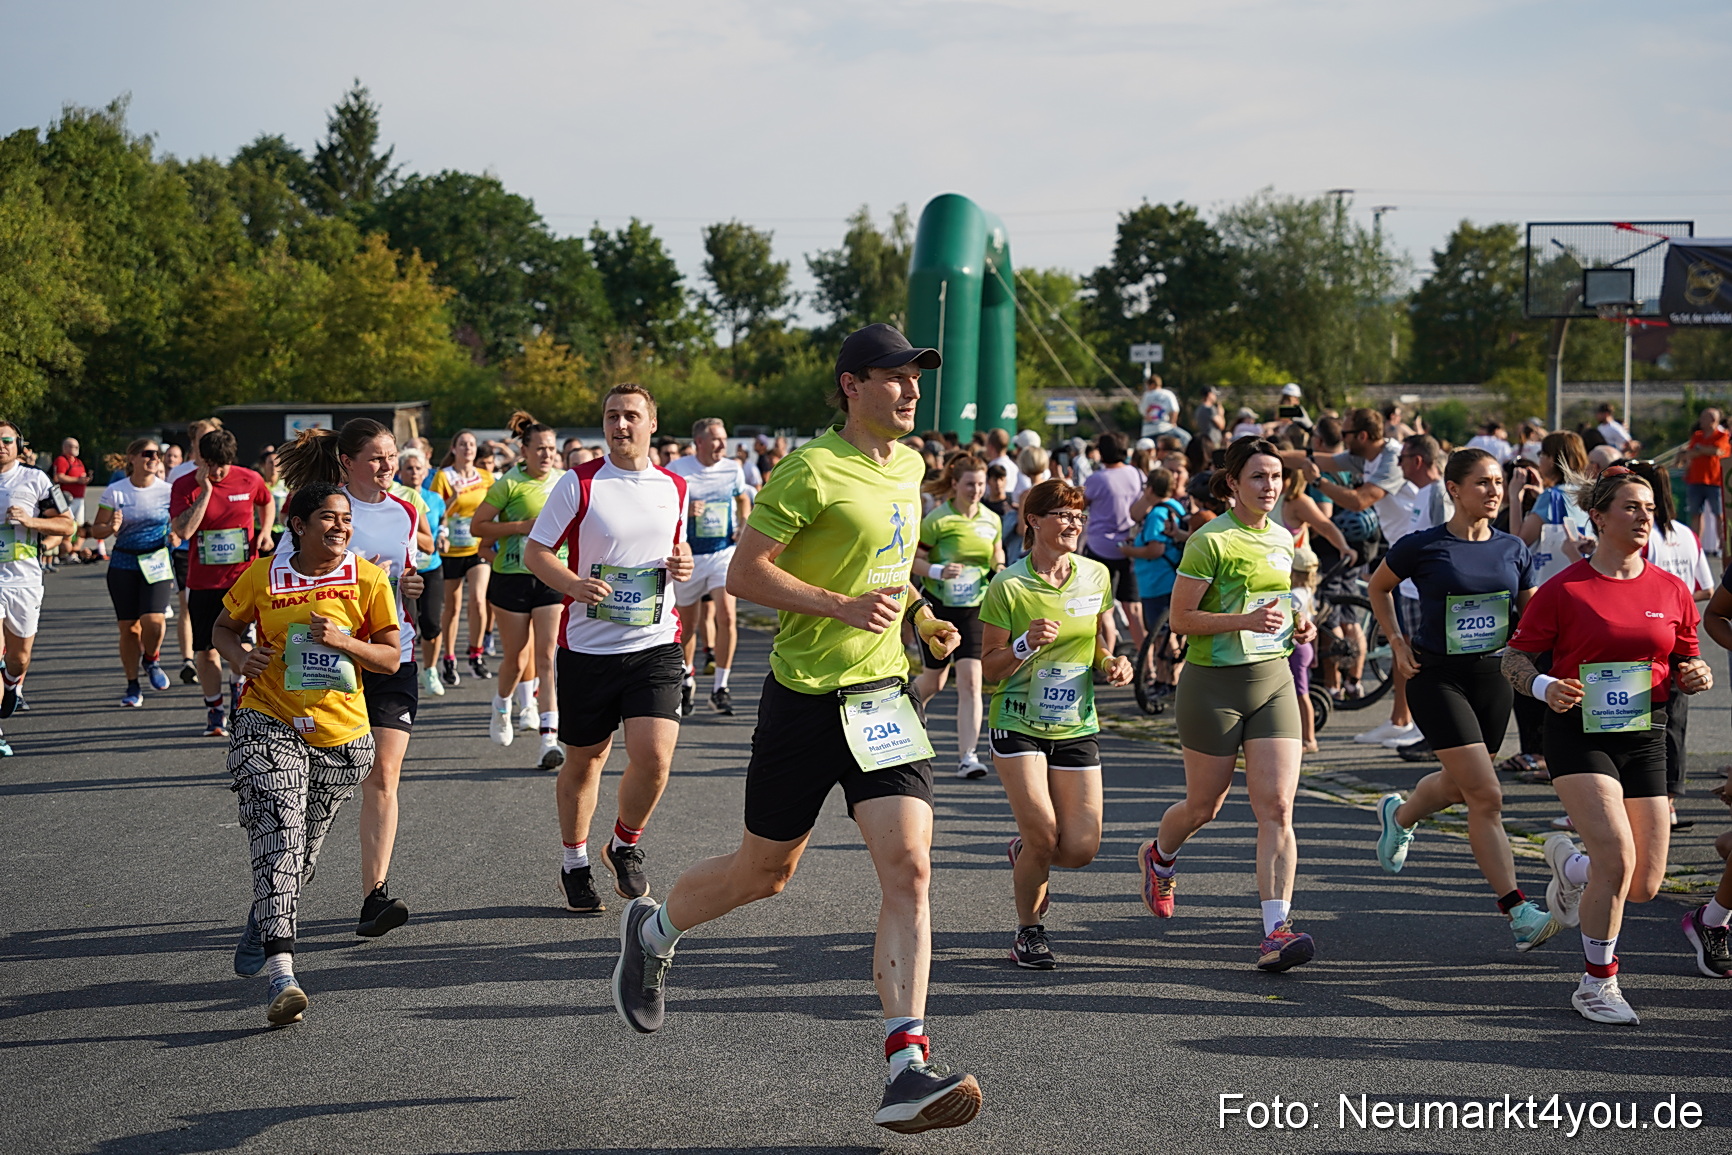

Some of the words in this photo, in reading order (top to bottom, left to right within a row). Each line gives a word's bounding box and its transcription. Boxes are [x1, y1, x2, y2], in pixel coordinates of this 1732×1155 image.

[211, 543, 236, 552] 2800
[271, 594, 310, 610] MAX
[315, 588, 358, 601] BÖGL
[613, 591, 642, 604] 526
[599, 603, 626, 611] Christoph
[1456, 615, 1496, 631] 2203
[301, 652, 340, 668] 1587
[1043, 687, 1076, 702] 1378
[1606, 691, 1629, 706] 68
[1040, 702, 1064, 710] Krystyna
[1615, 708, 1644, 716] Schweiger
[863, 721, 901, 742] 234
[868, 742, 892, 753] Martin
[891, 737, 912, 747] Kraus
